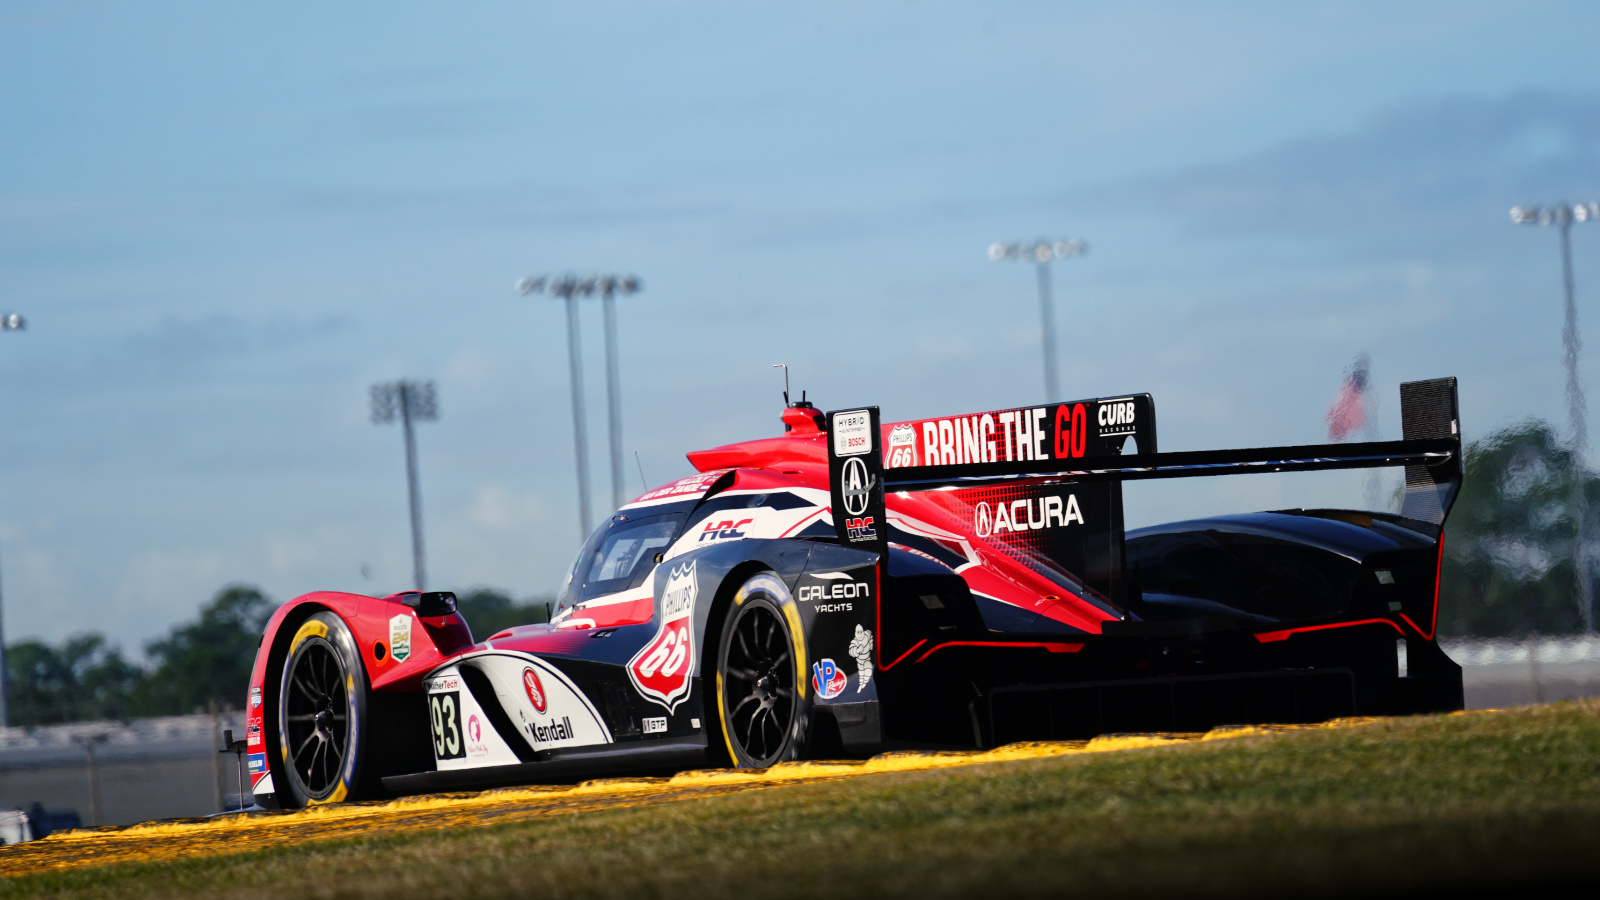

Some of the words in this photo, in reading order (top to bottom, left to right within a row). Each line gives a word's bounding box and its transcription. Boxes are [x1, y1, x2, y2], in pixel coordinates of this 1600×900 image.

[838, 415, 865, 428] HYBRID
[1097, 402, 1135, 426] CURB
[892, 432, 913, 443] PHILLIPS
[999, 407, 1049, 462] THE
[1054, 402, 1087, 460] GO
[1099, 425, 1136, 434] RECORDS
[848, 436, 866, 448] BOSCH
[891, 447, 912, 468] 66
[992, 493, 1085, 534] ACURA
[698, 518, 754, 542] HRC
[845, 516, 877, 539] HRC
[664, 584, 693, 618] PHILLIPS
[798, 582, 870, 602] GALEON
[814, 602, 853, 613] YACHTS
[391, 631, 409, 645] 24
[639, 626, 689, 678] 66
[812, 658, 837, 697] VP
[431, 694, 460, 756] 93
[528, 715, 575, 743] Kendall
[651, 719, 666, 730] GTP
